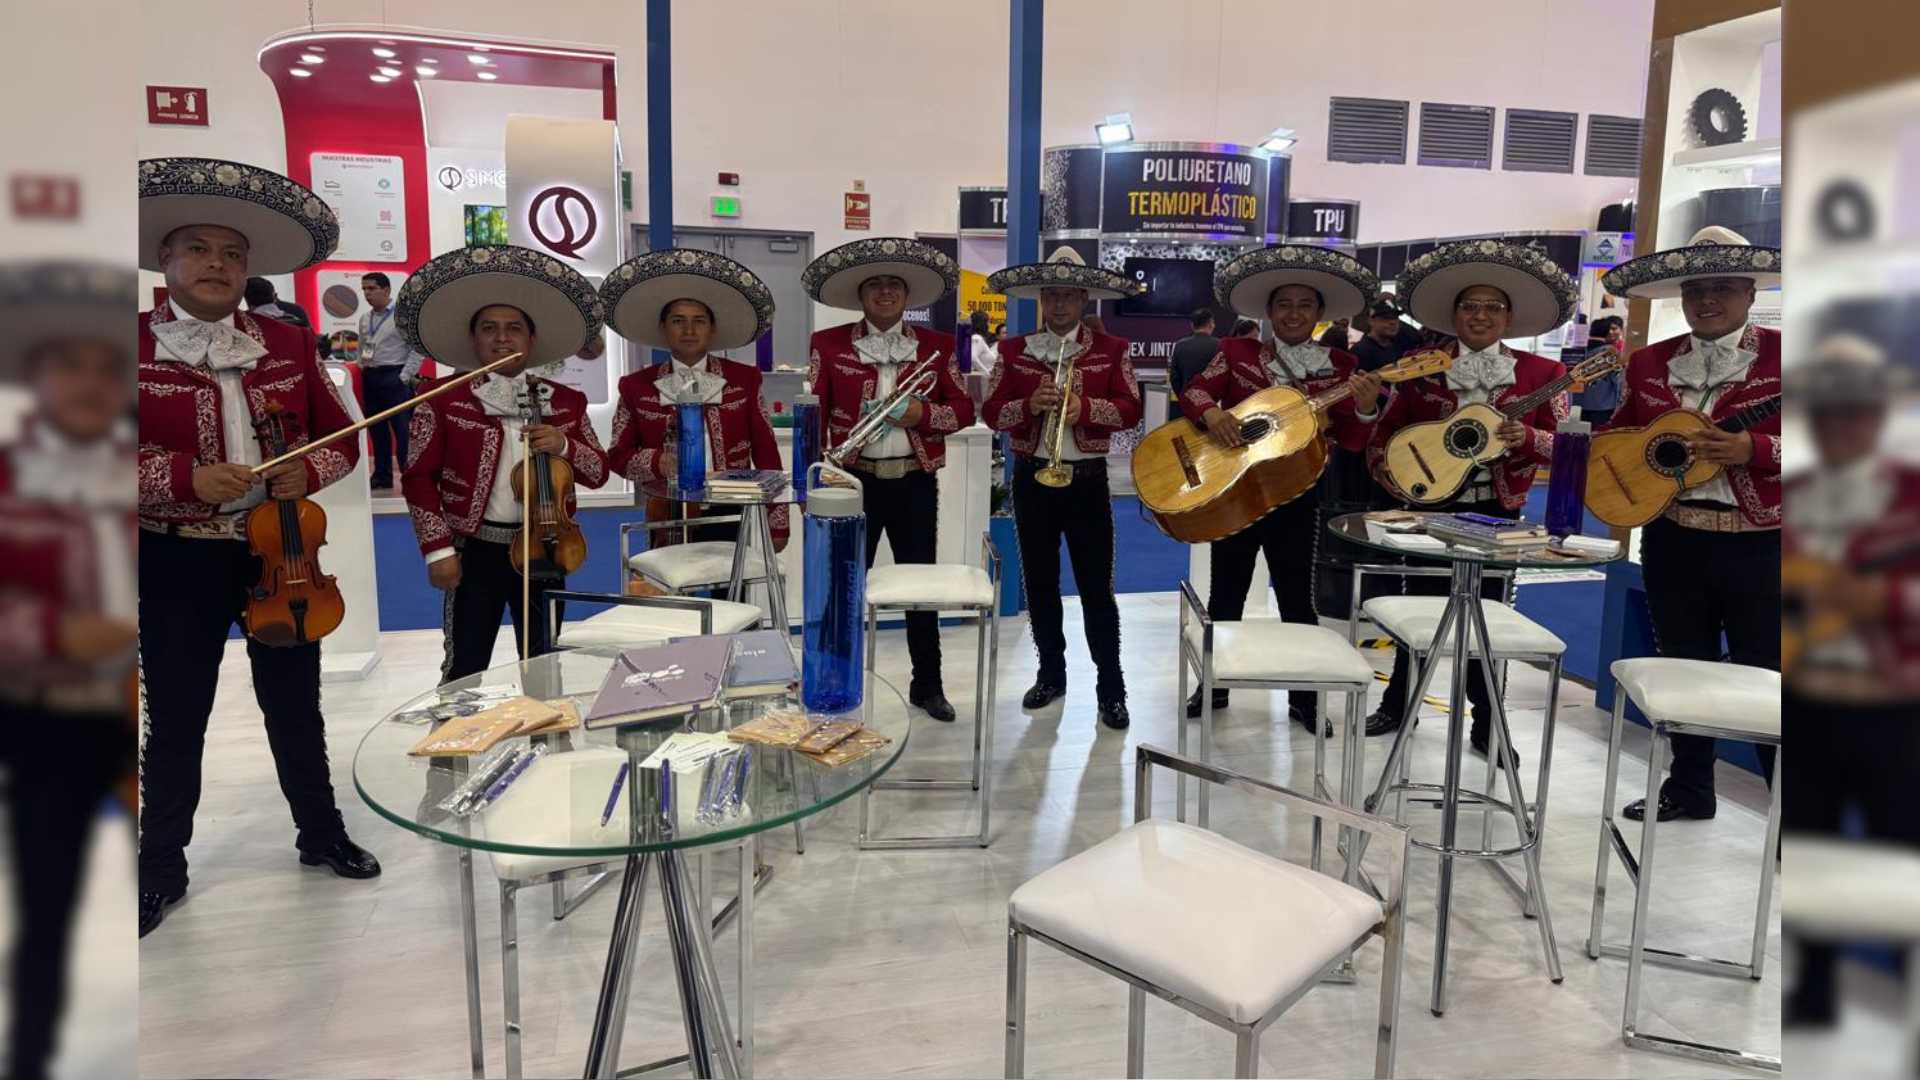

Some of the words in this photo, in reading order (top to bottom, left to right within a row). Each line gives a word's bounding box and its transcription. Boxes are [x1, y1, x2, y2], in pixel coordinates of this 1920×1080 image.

[1142, 158, 1251, 186] POLIURETANO
[1128, 188, 1257, 219] TERMOPLÁSTICO
[1313, 209, 1345, 232] TPU
